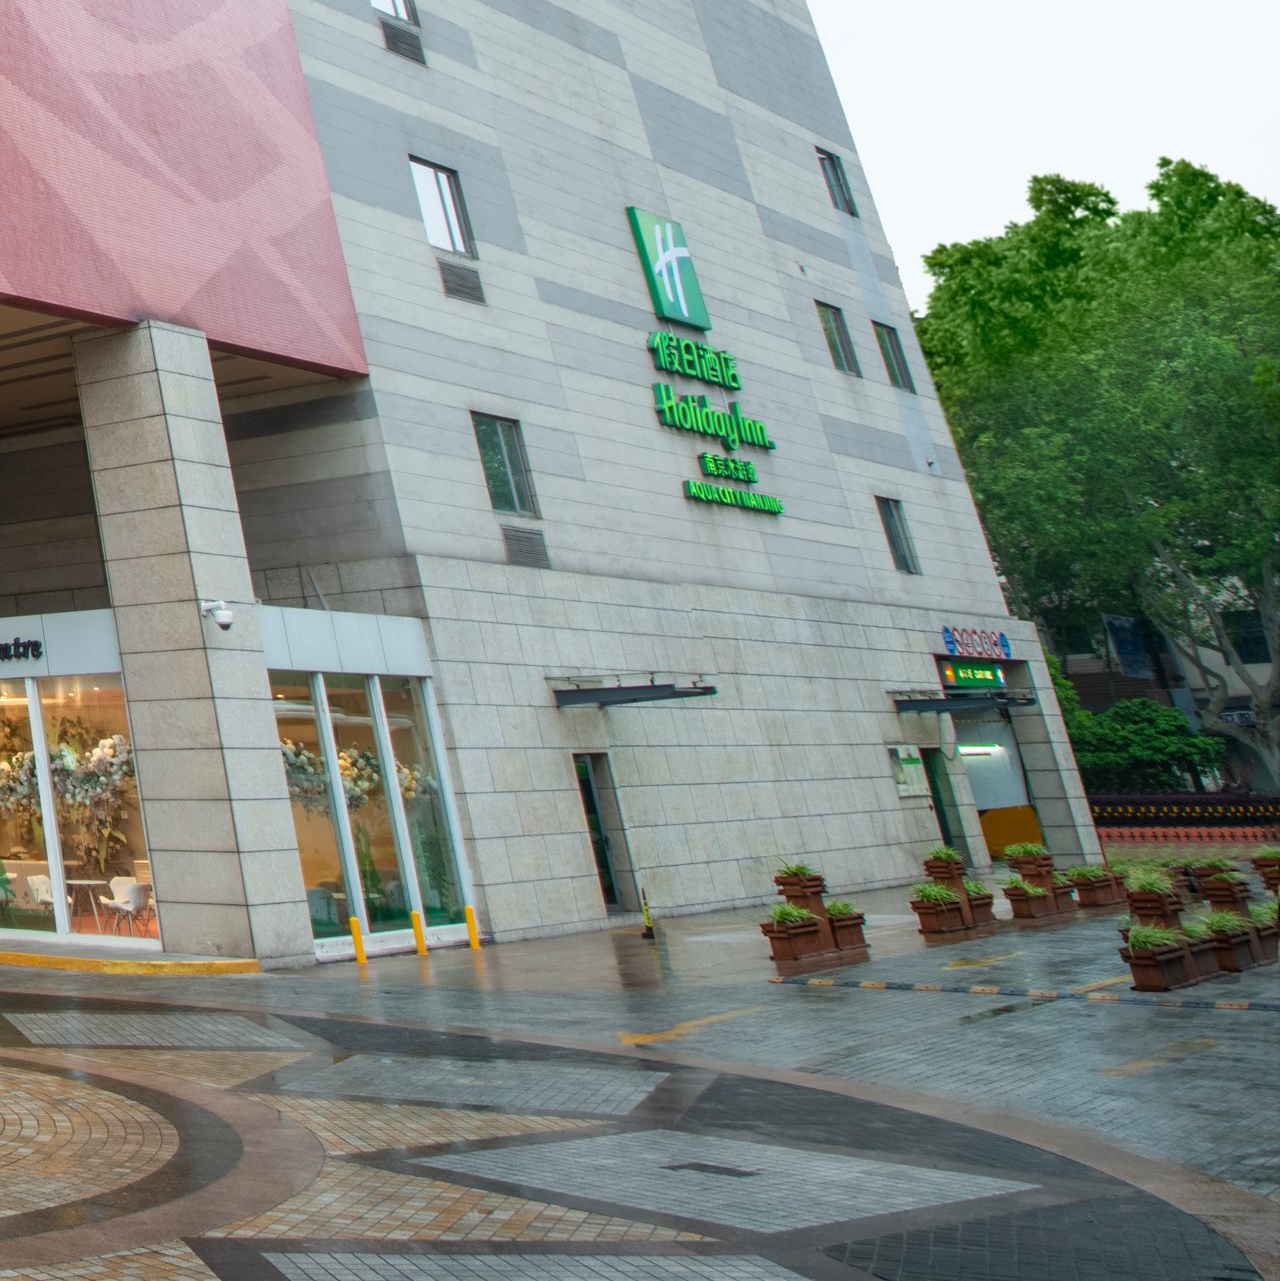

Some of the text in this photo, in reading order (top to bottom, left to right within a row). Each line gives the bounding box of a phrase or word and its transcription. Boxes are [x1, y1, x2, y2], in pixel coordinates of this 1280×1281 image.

[648, 330, 741, 390] 假日酒店
[653, 382, 772, 451] Holiday Inn
[685, 479, 720, 502] AQUA
[717, 486, 742, 507] CITY
